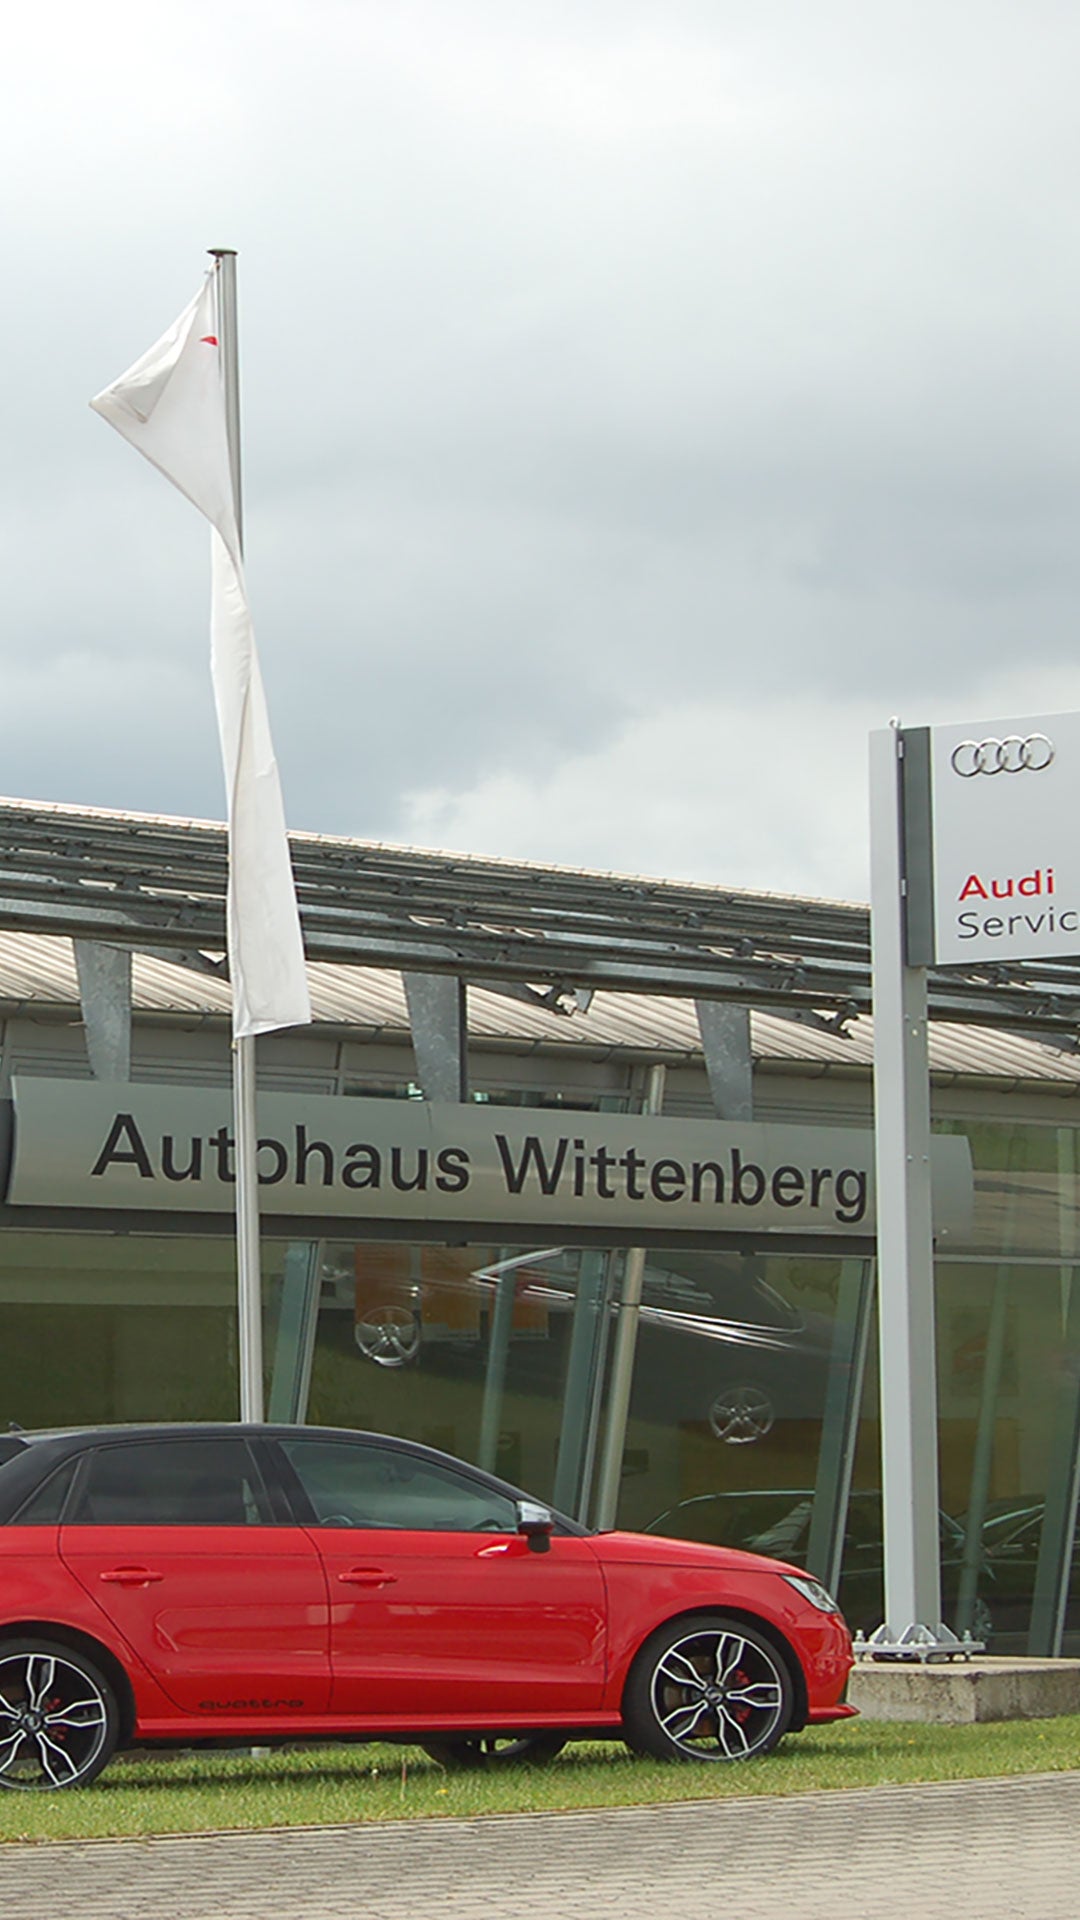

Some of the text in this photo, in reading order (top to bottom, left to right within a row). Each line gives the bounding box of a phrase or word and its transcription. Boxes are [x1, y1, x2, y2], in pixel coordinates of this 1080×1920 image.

[958, 867, 1055, 902] Audi
[91, 1113, 868, 1224] Autohaus Wittenberg
[198, 1698, 304, 1710] quattro
